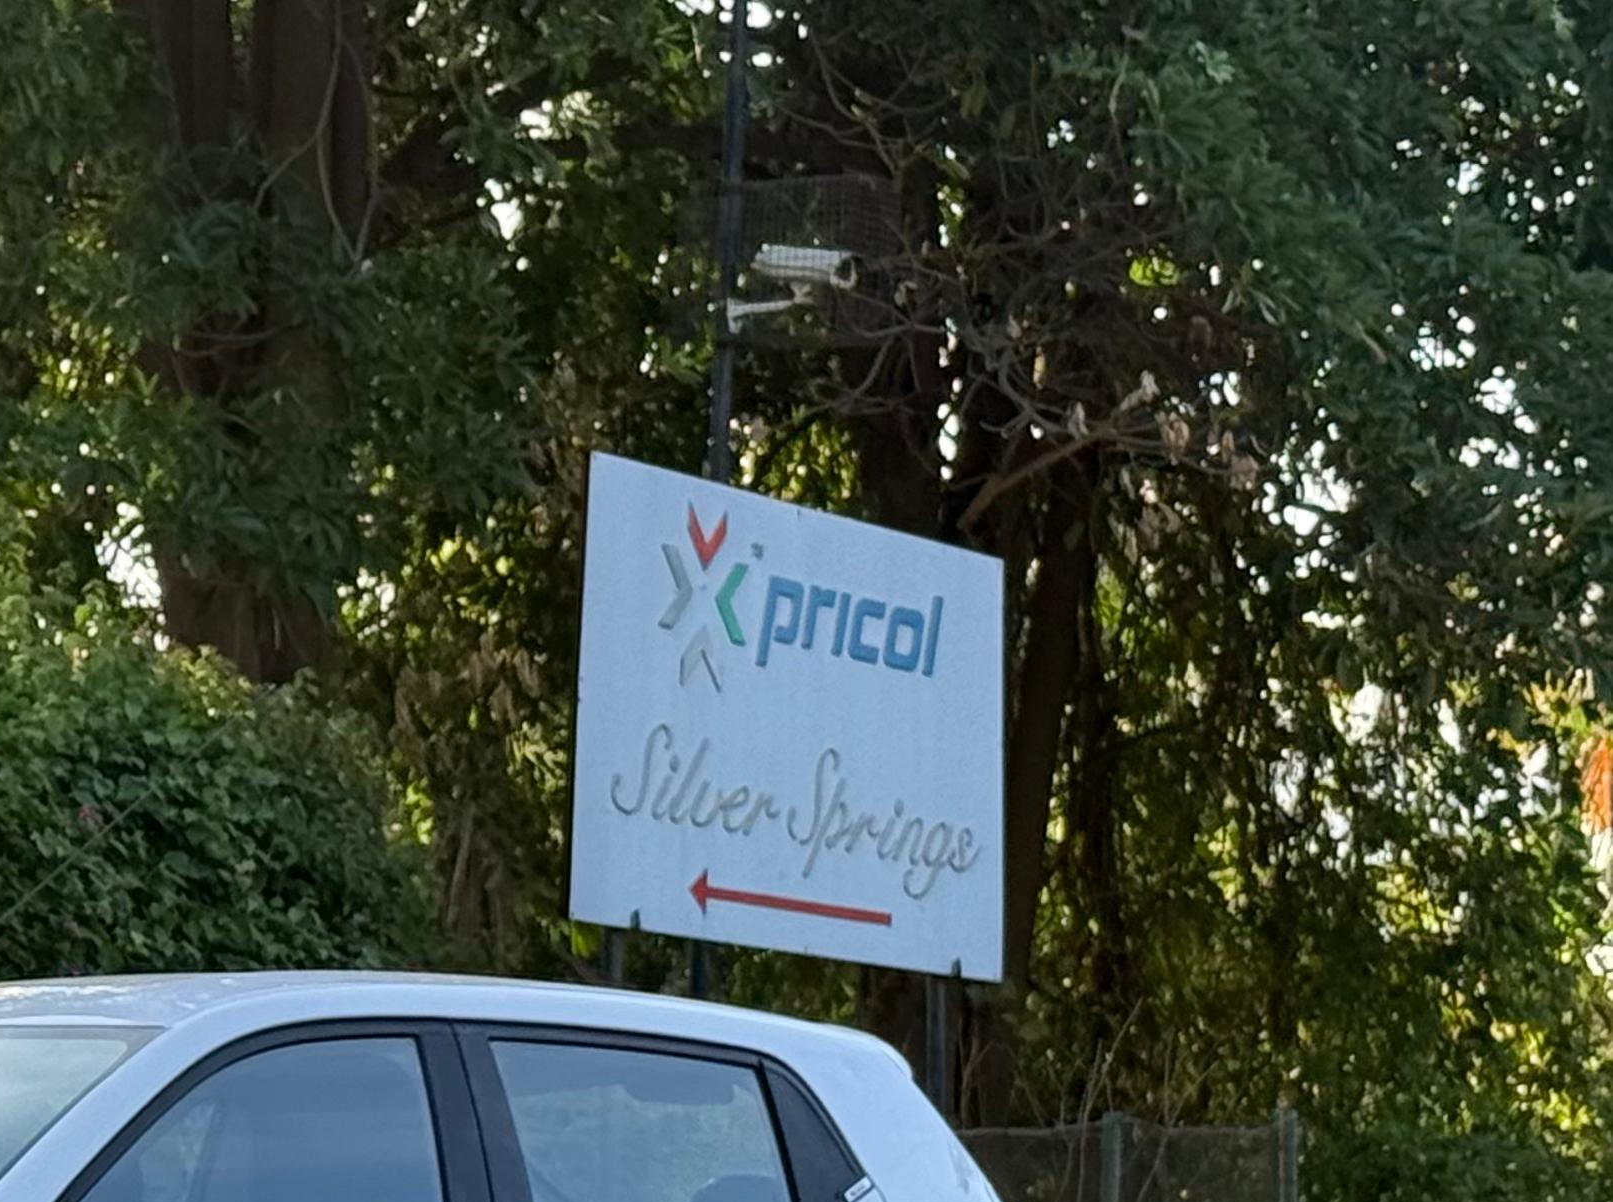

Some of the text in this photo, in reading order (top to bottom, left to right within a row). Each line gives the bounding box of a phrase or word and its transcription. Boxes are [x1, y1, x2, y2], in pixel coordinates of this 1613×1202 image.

[755, 575, 944, 676] pricol
[610, 723, 980, 900] Silver Springs
